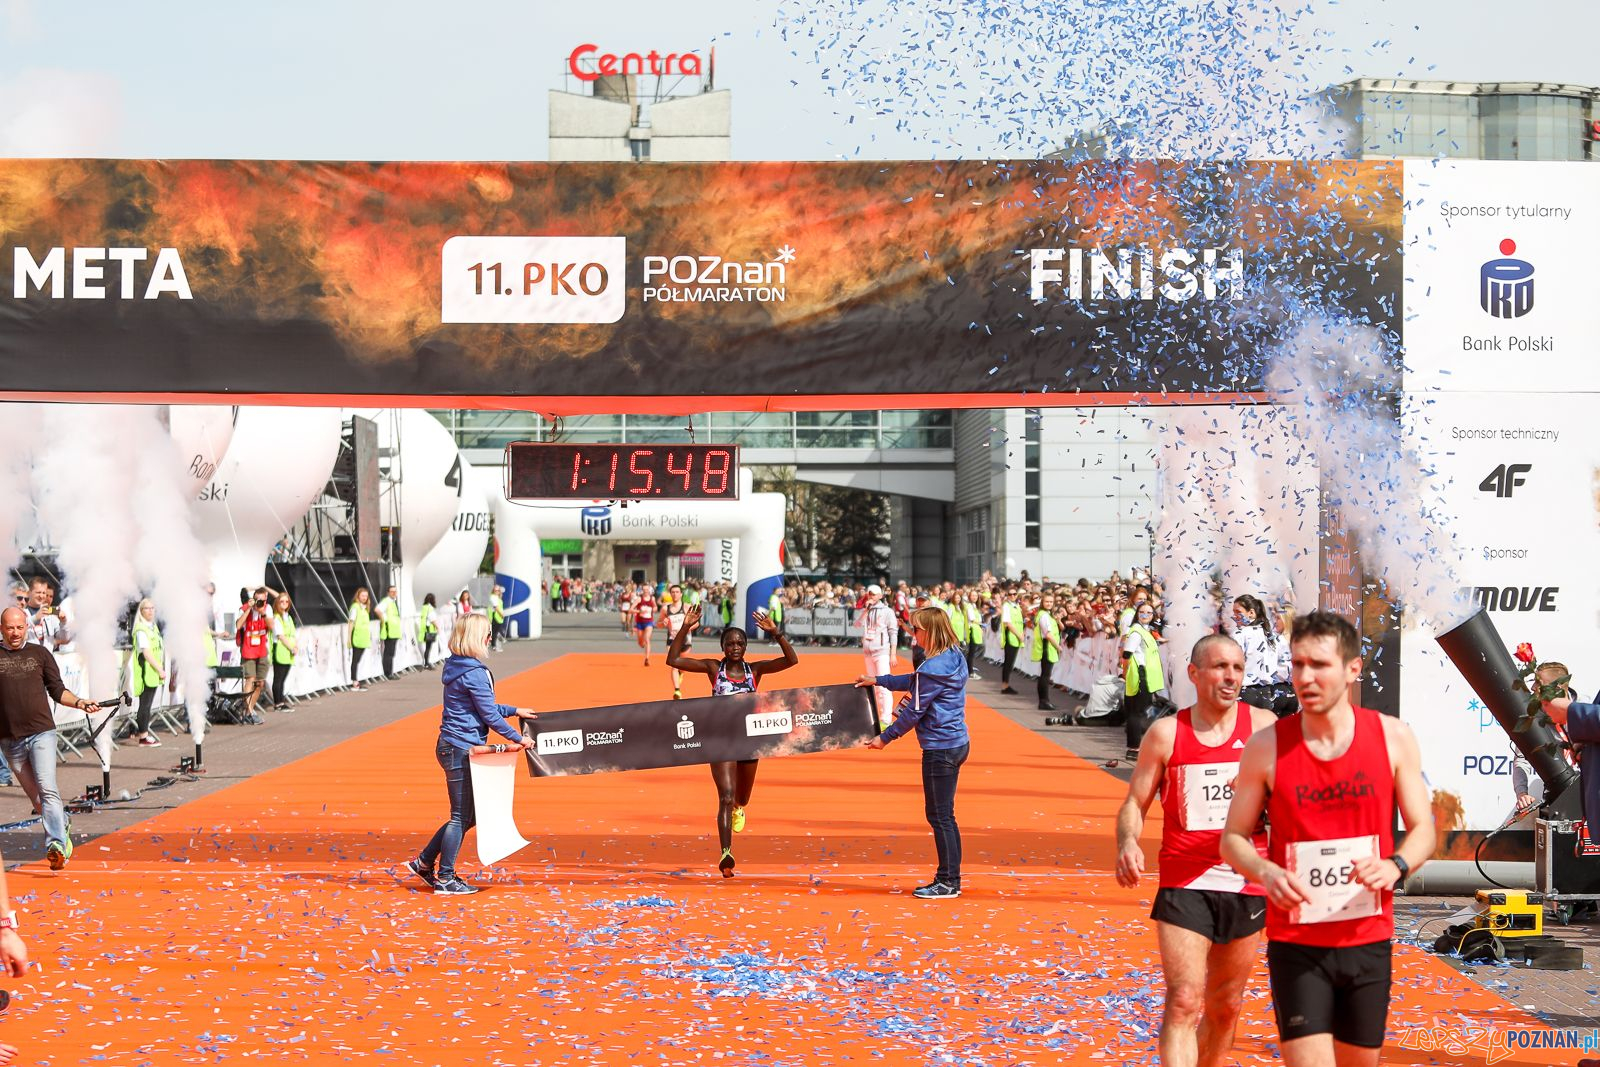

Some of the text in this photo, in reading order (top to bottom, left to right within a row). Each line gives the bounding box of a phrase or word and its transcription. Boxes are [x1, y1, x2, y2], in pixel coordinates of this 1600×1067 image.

[569, 43, 702, 81] Centra
[1440, 203, 1572, 220] Sponsor tytularny
[13, 247, 194, 300] META
[467, 262, 609, 296] 11. PKO
[1030, 248, 1244, 301] FINISH
[643, 284, 786, 302] PÓŁMARATON
[1462, 335, 1553, 351] Bank Polski
[1451, 426, 1560, 442] Sponsor techniczny
[572, 450, 730, 494] 1:15.48
[1479, 463, 1533, 498] 4F
[622, 514, 699, 528] Bank Polski
[1483, 545, 1529, 560] Sponsor
[1458, 586, 1560, 612] MOVE
[766, 717, 788, 728] PKO
[557, 736, 579, 746] PKO
[1309, 866, 1352, 888] 865
